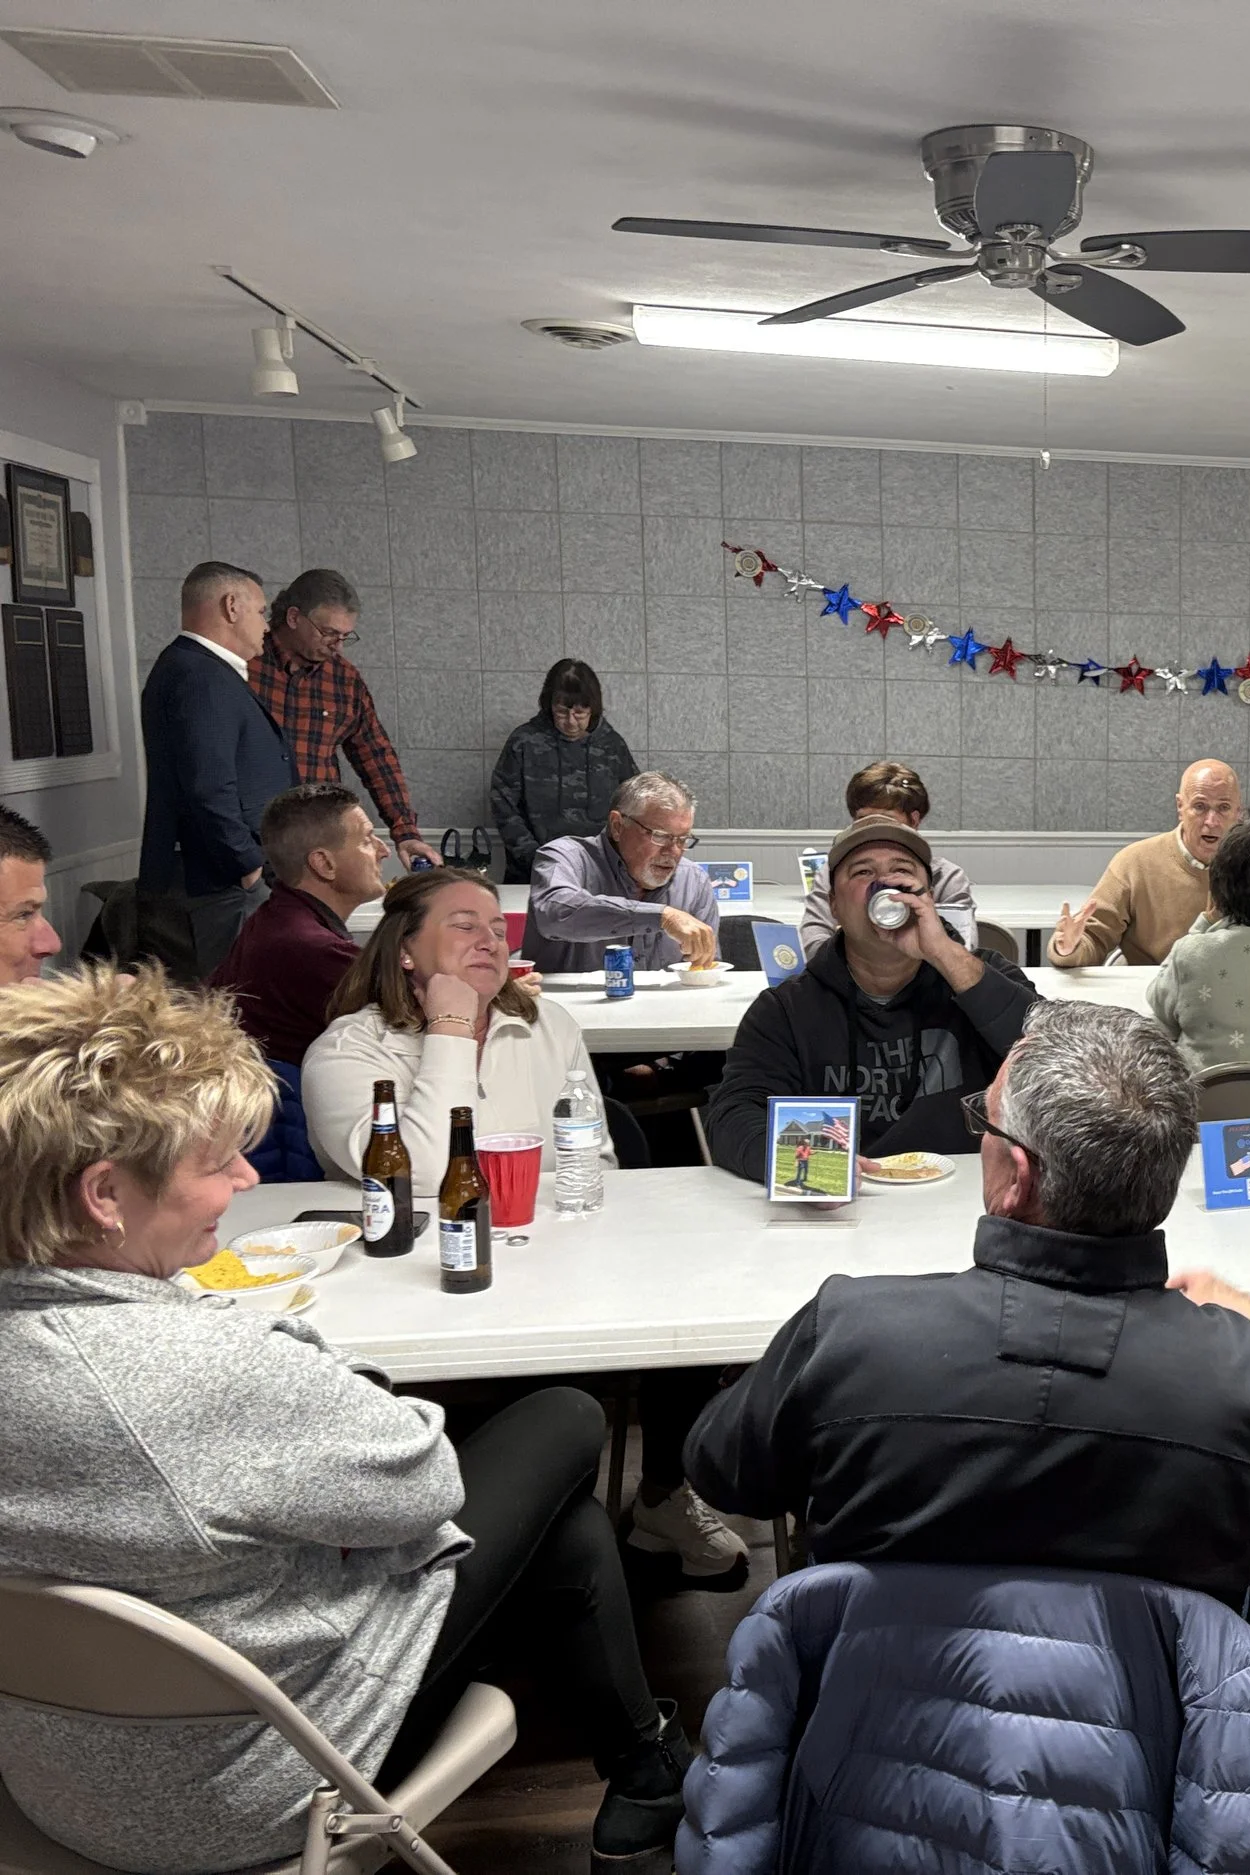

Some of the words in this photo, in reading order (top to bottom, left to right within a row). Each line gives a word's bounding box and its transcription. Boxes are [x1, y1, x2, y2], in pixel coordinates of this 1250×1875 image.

[605, 970, 624, 978] UD
[606, 978, 628, 987] GHT
[867, 1037, 914, 1068] THE
[861, 1094, 902, 1122] FAC
[364, 1203, 390, 1213] TRA
